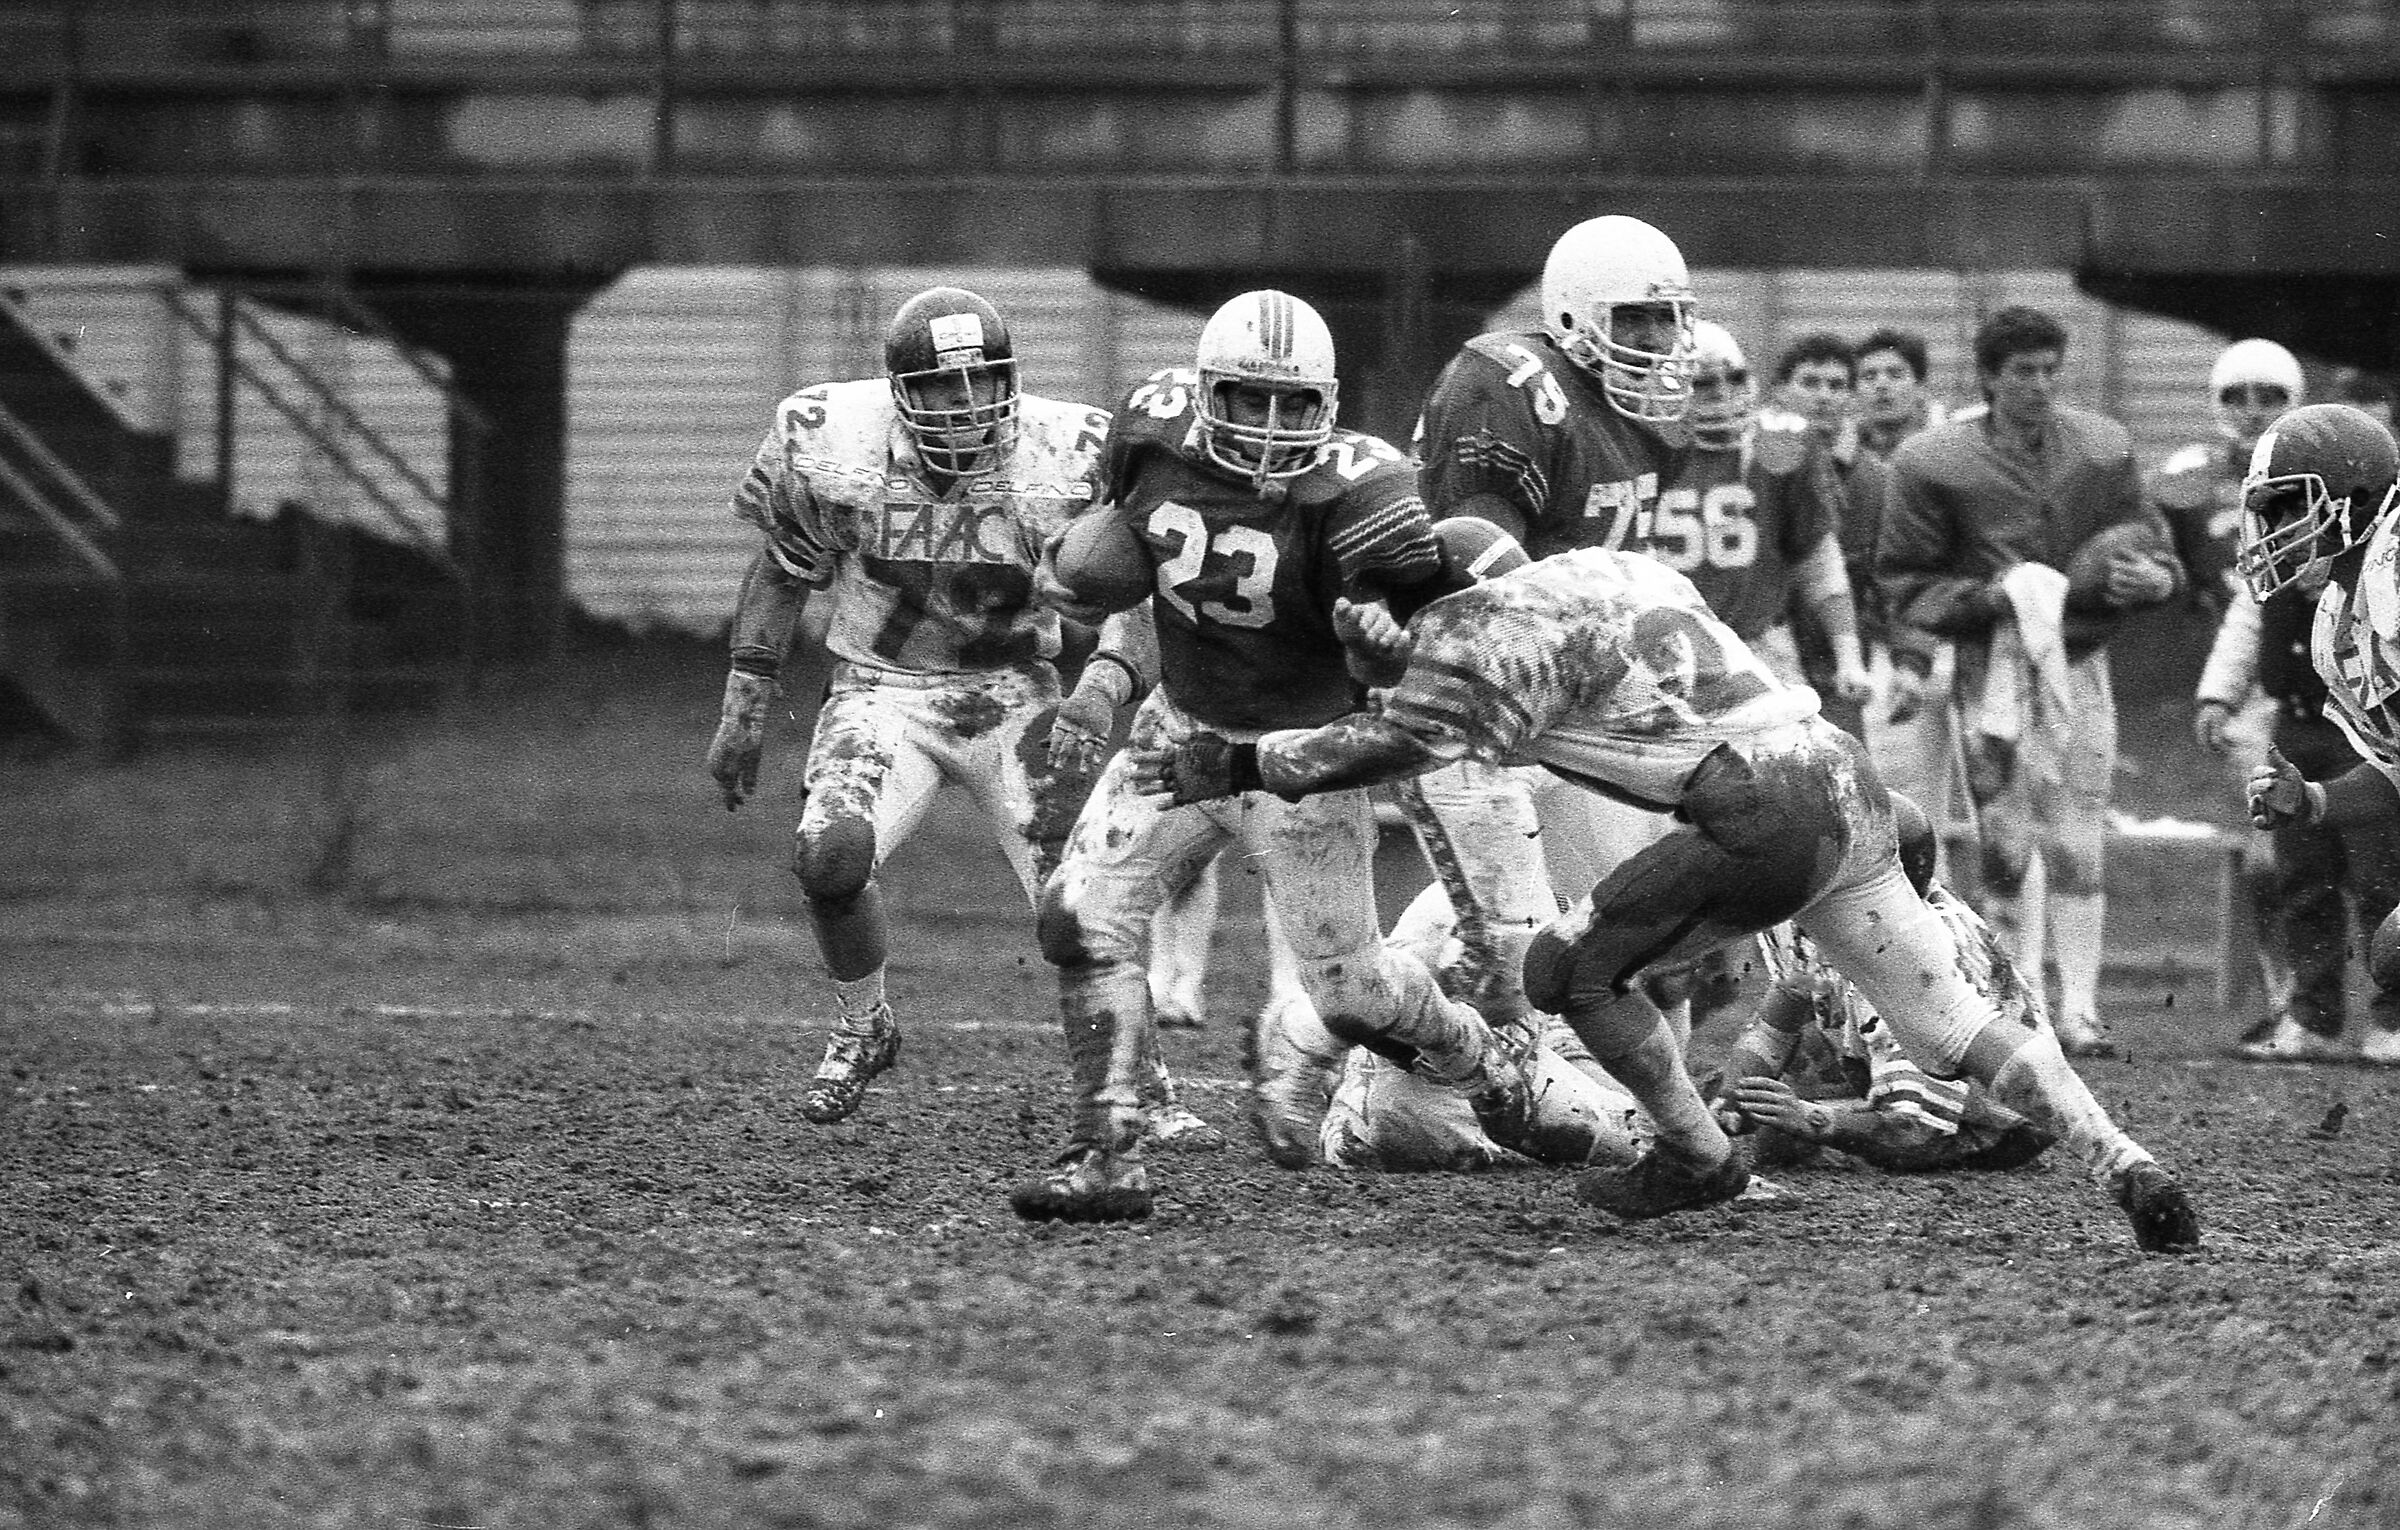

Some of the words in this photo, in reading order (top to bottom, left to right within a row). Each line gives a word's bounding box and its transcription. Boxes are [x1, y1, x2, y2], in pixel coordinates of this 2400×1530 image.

[879, 502, 1005, 562] FAAC
[1148, 501, 1279, 628] 23
[1654, 484, 1757, 571] 56
